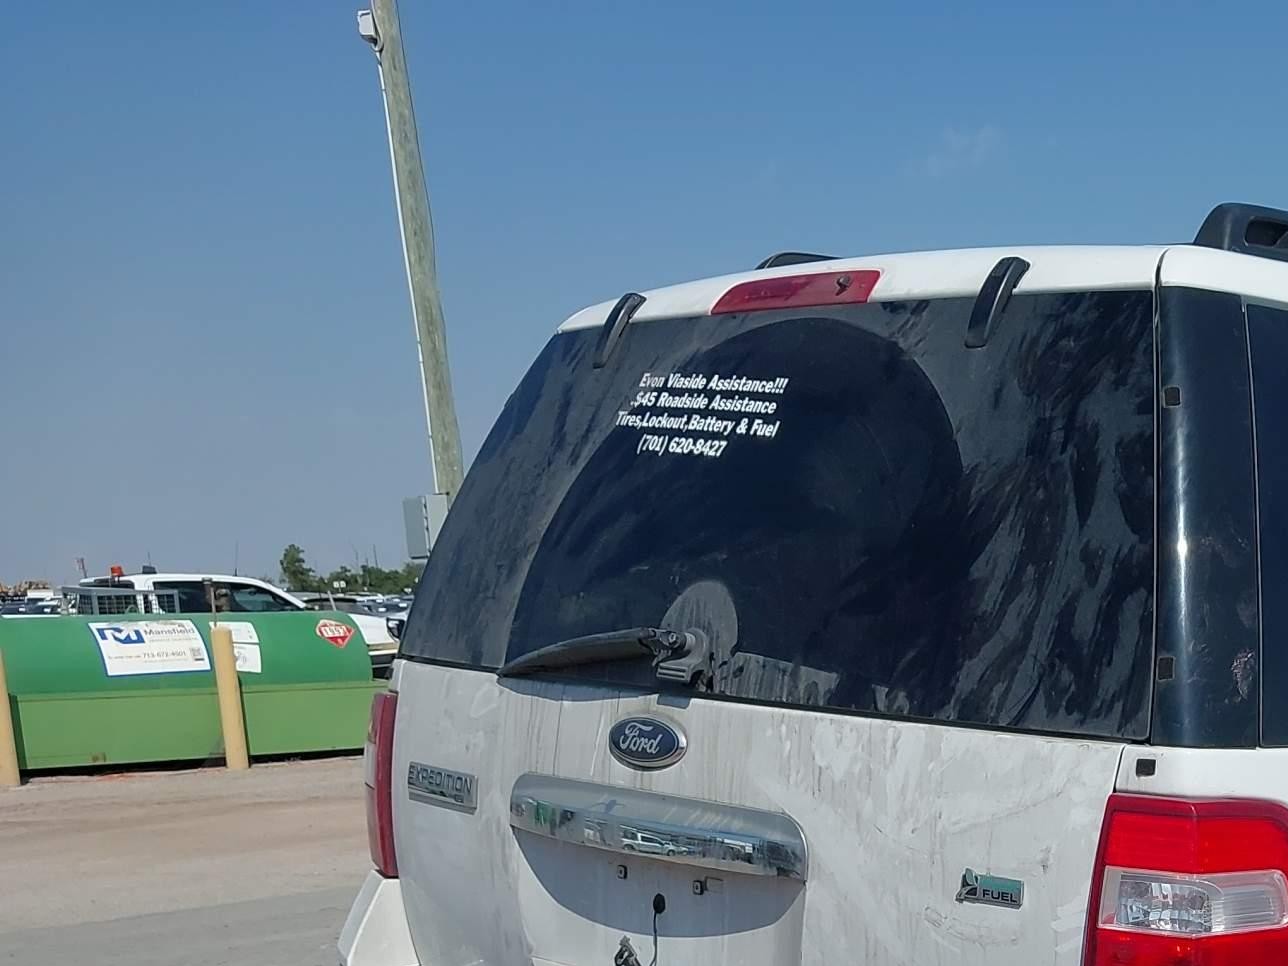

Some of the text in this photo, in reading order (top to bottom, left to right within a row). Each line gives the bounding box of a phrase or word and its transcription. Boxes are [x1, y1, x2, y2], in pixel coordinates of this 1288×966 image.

[639, 373, 788, 394] Evon Viaside Assistance!!!
[656, 392, 708, 409] Roadside
[708, 394, 777, 414] Assistance
[736, 418, 747, 434] &
[750, 419, 780, 437] Fuel
[637, 434, 727, 457] (701) 620-8427
[144, 627, 196, 636] Mansfield
[620, 722, 663, 754] Ford
[408, 764, 473, 793] EXPEDITION
[982, 888, 1018, 904] FUEL
